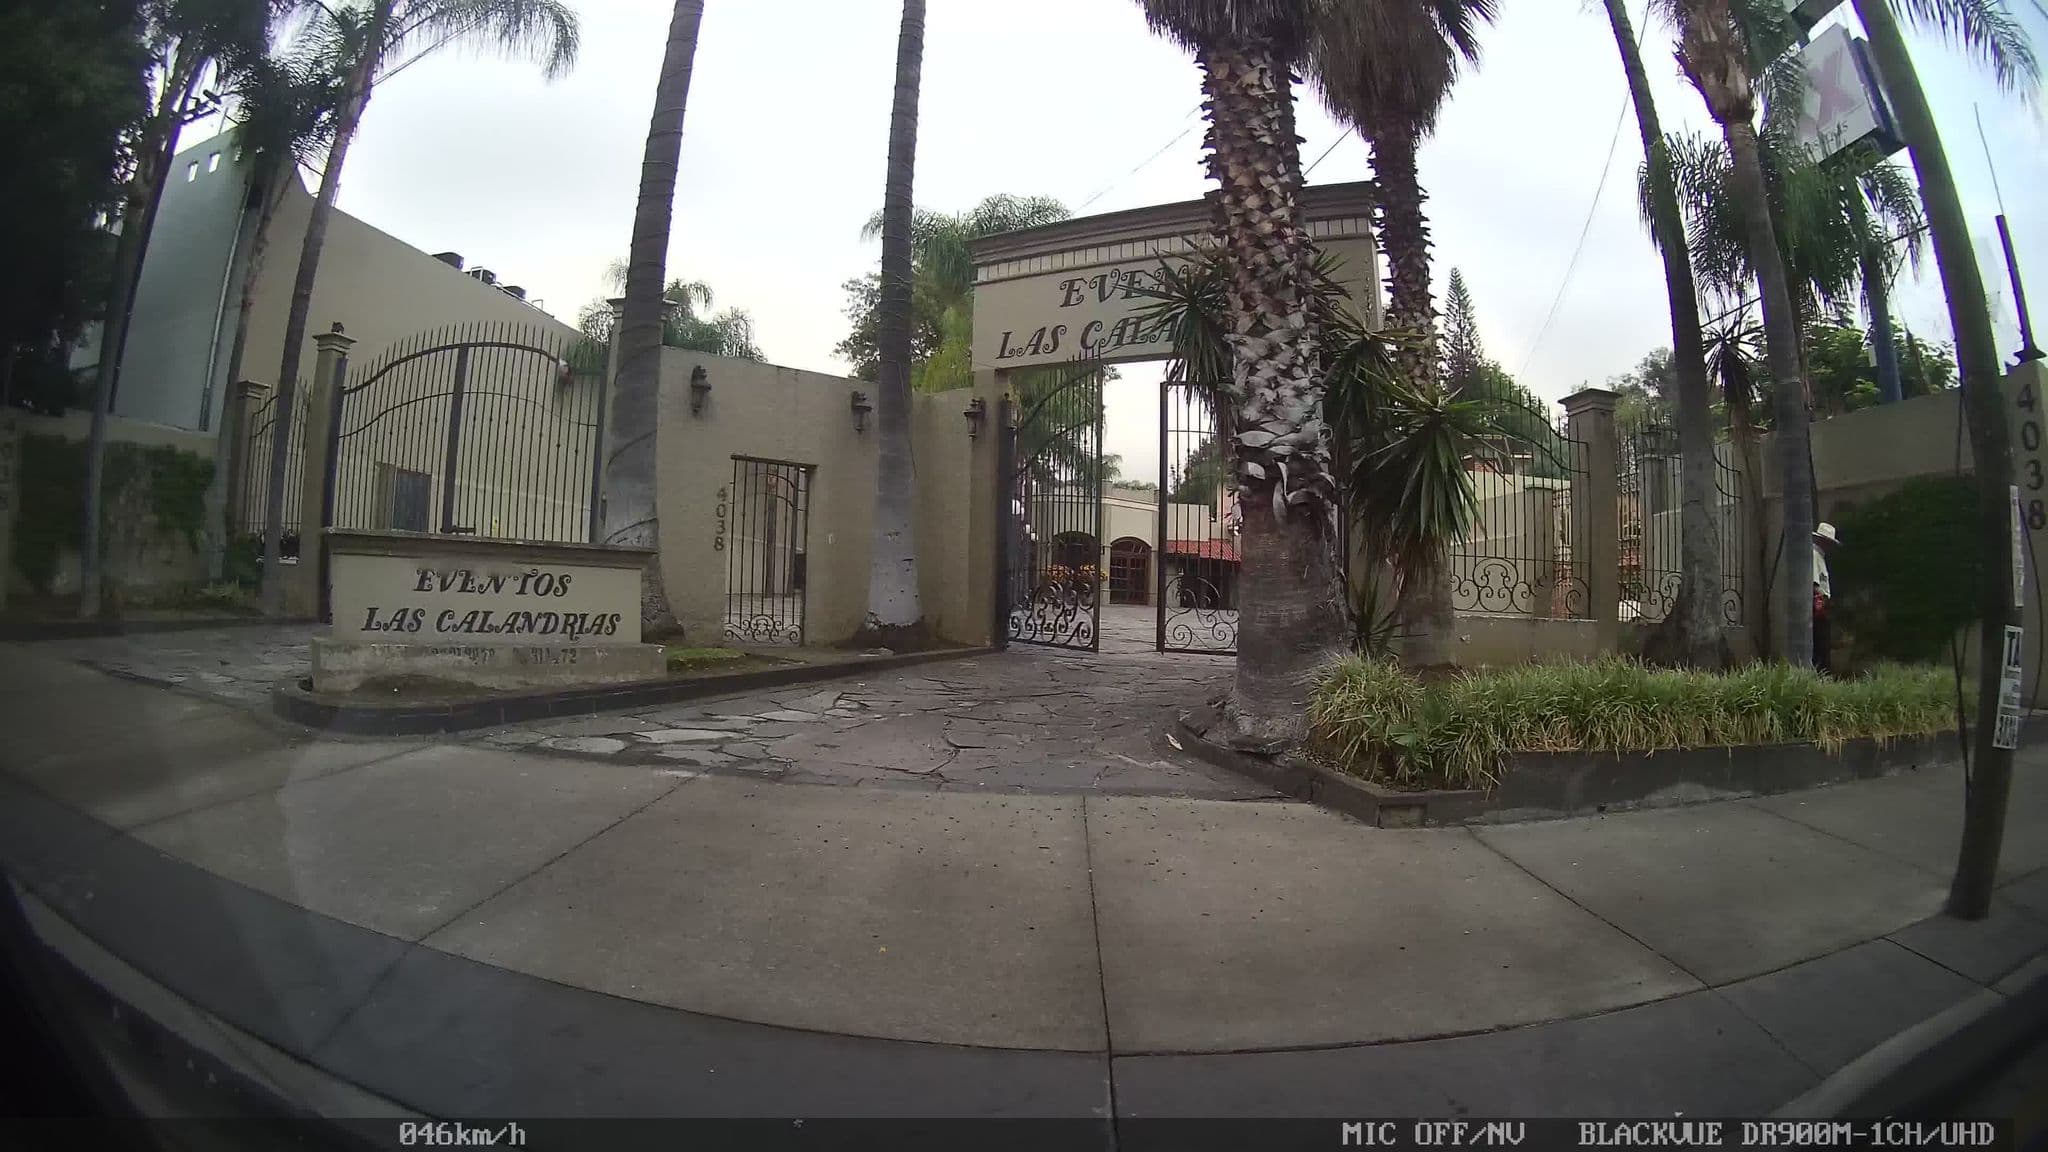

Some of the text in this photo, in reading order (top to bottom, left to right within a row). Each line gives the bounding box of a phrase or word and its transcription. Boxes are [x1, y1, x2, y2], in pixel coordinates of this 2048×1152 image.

[995, 312, 1184, 360] LAS CALA
[2018, 383, 2046, 530] 4038
[412, 568, 572, 597] EVENTOS
[361, 607, 622, 642] LAS CALANDRIAS
